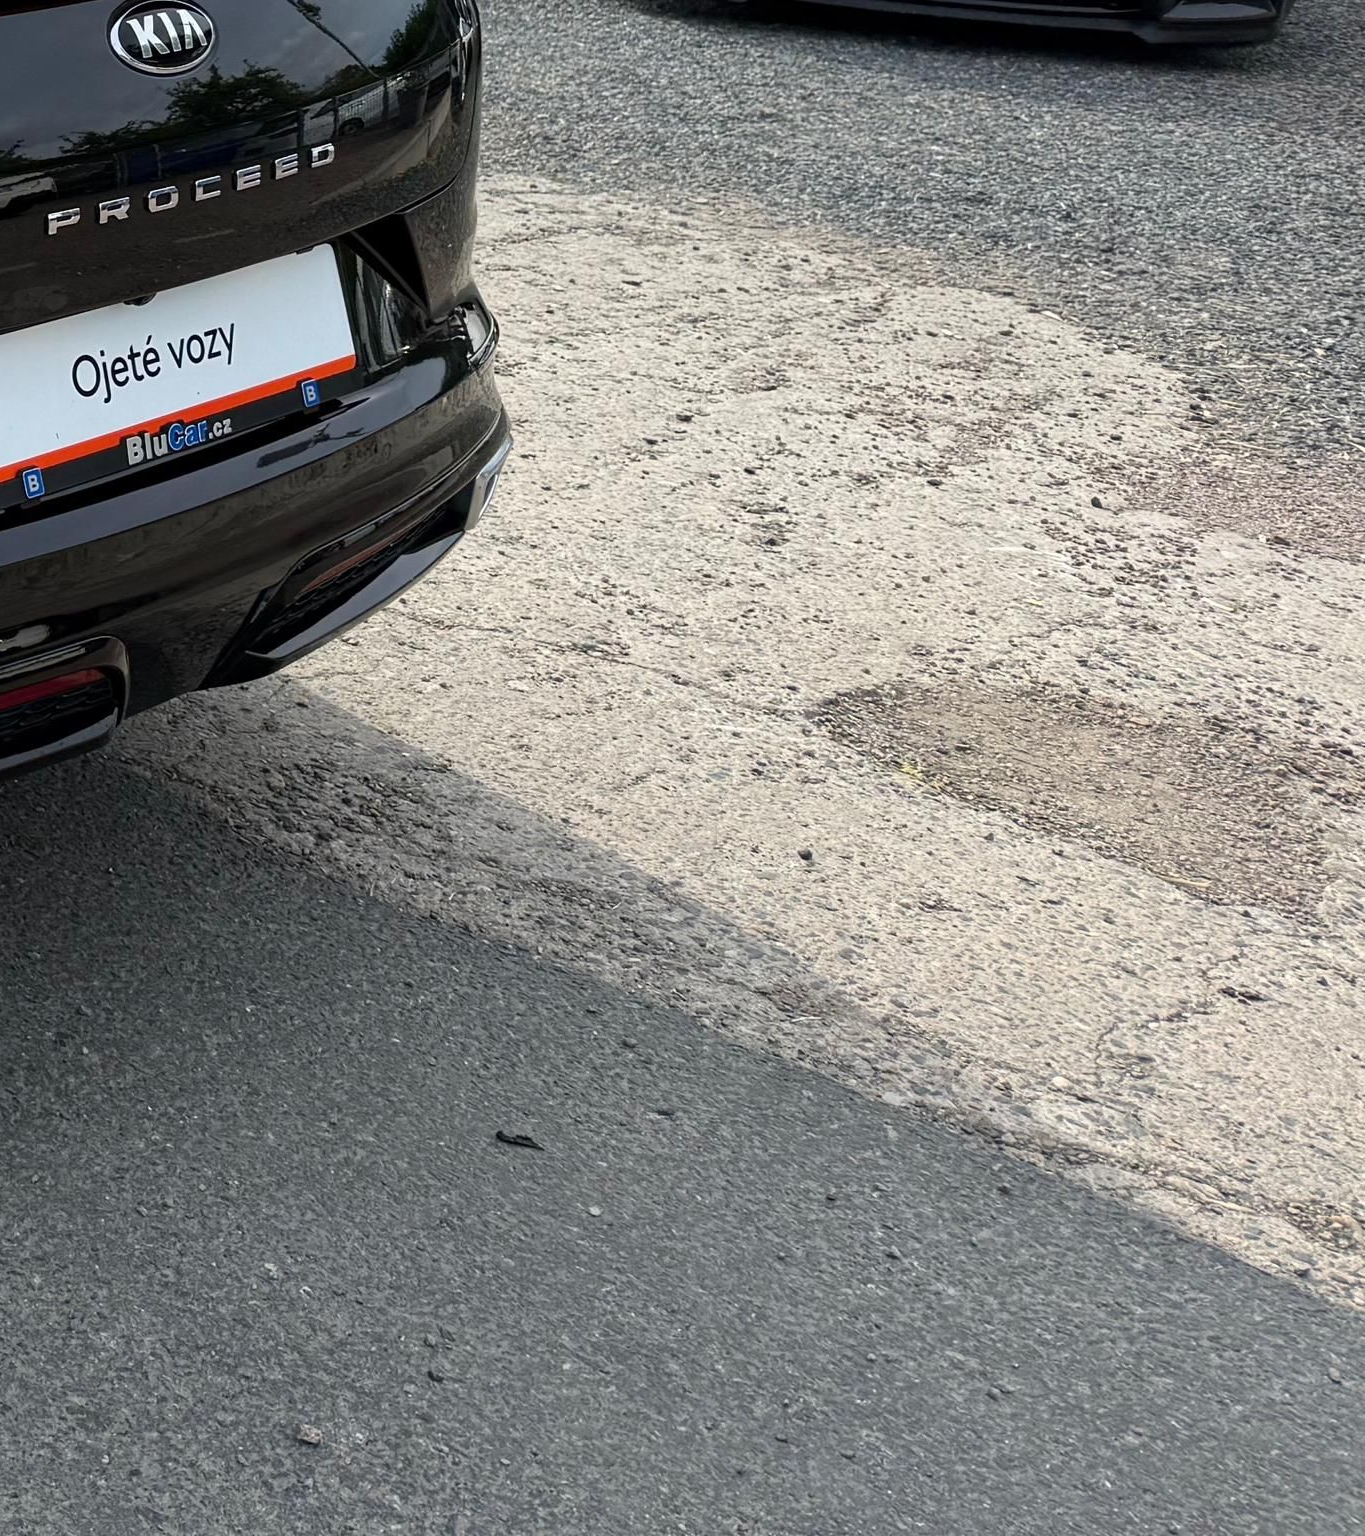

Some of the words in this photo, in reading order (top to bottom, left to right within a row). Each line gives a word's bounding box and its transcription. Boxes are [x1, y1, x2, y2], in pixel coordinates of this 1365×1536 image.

[126, 8, 208, 59] KIA
[46, 142, 336, 236] PROCEED
[72, 334, 161, 404] Ojeté
[167, 323, 234, 366] vozy
[304, 385, 317, 399] B
[126, 418, 233, 465] BluCar.cz
[27, 474, 40, 493] B
